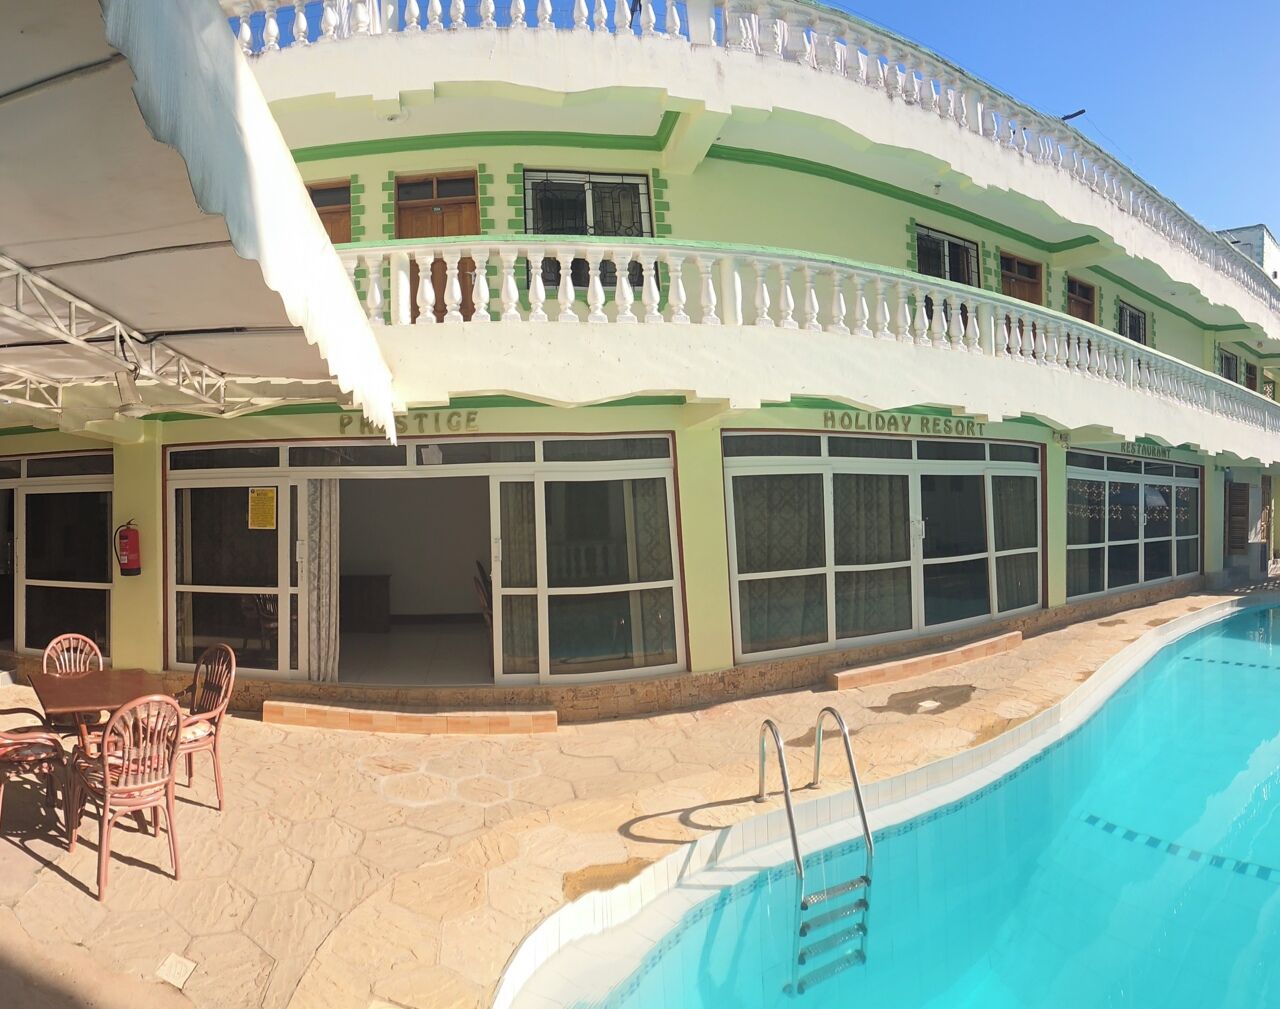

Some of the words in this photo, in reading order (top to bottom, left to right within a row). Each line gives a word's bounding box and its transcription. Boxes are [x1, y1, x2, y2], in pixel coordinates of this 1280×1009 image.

[339, 411, 479, 434] PRSTIGE
[823, 411, 911, 432] HOLIDAY
[920, 416, 985, 436] RESORT
[1121, 442, 1170, 458] RESTAURANT
